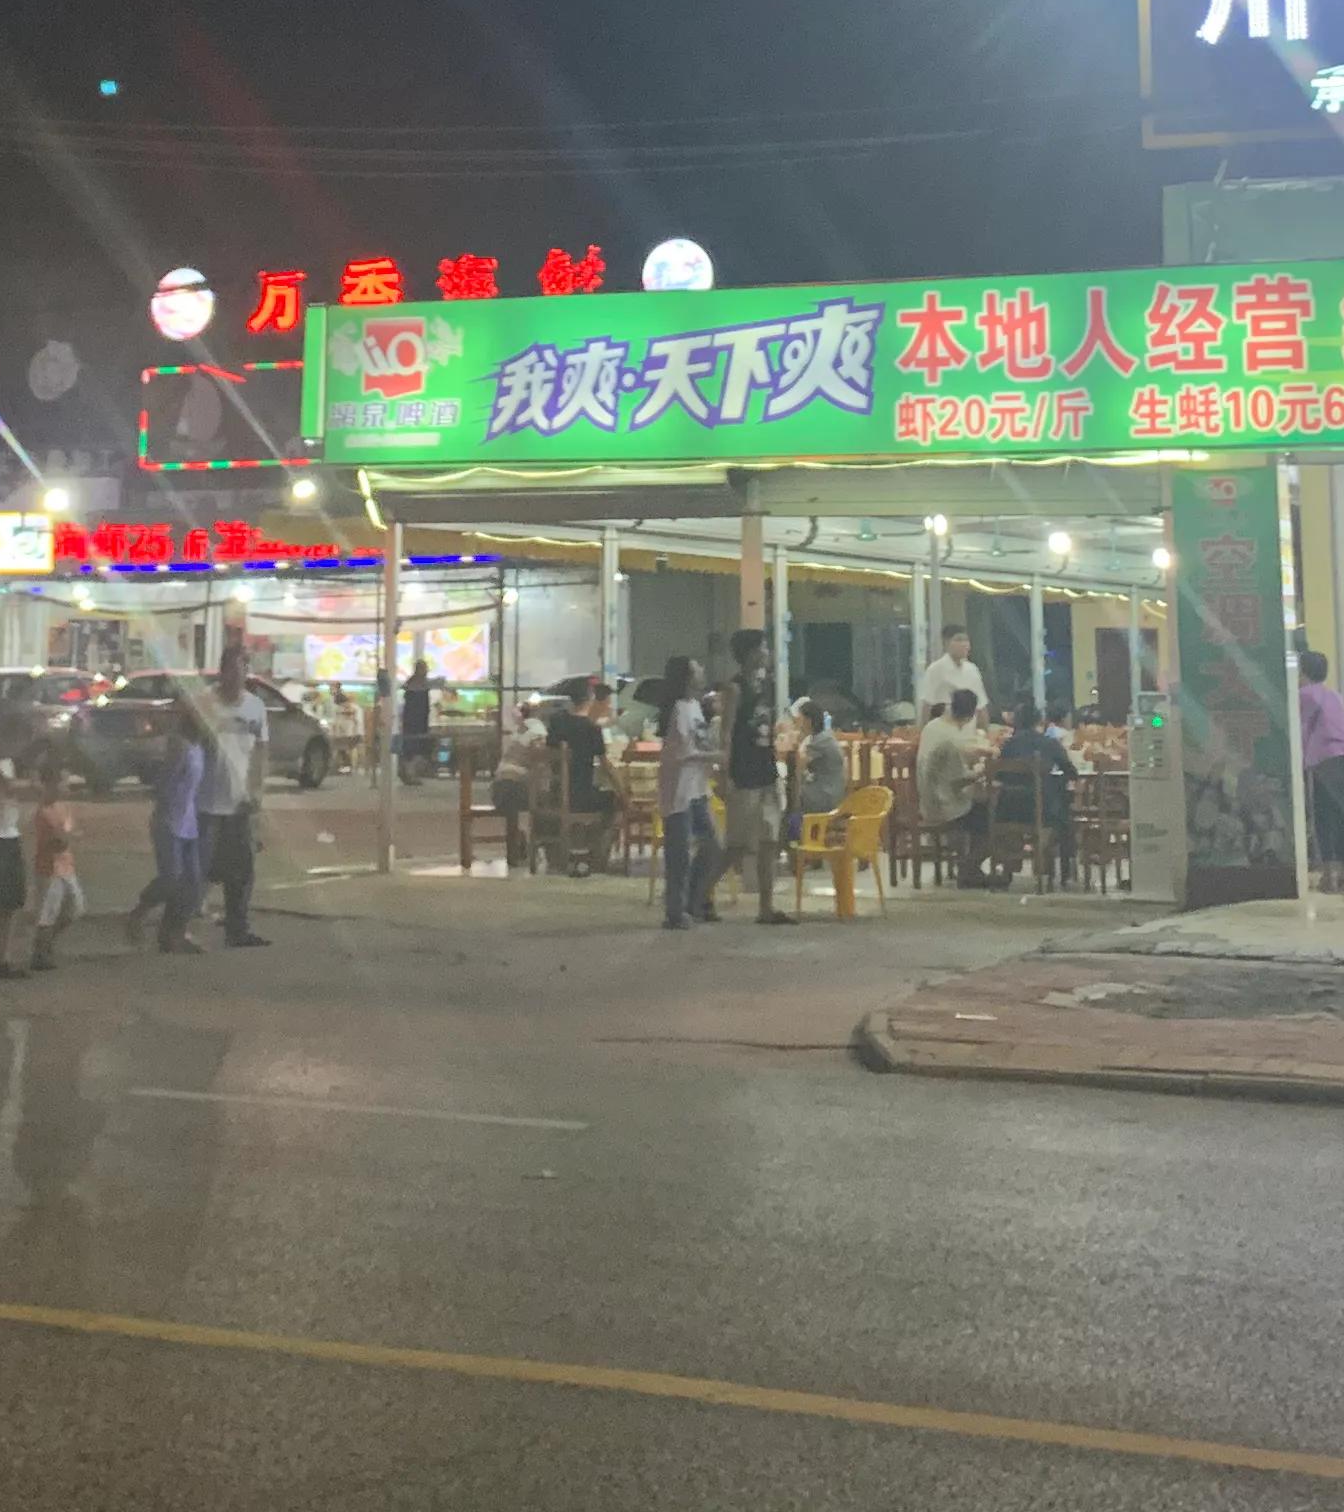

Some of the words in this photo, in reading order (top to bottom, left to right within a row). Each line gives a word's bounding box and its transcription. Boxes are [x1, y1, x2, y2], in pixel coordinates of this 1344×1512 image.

[897, 276, 1313, 386] 本地人经营
[895, 388, 1092, 445] 虾20元/斤
